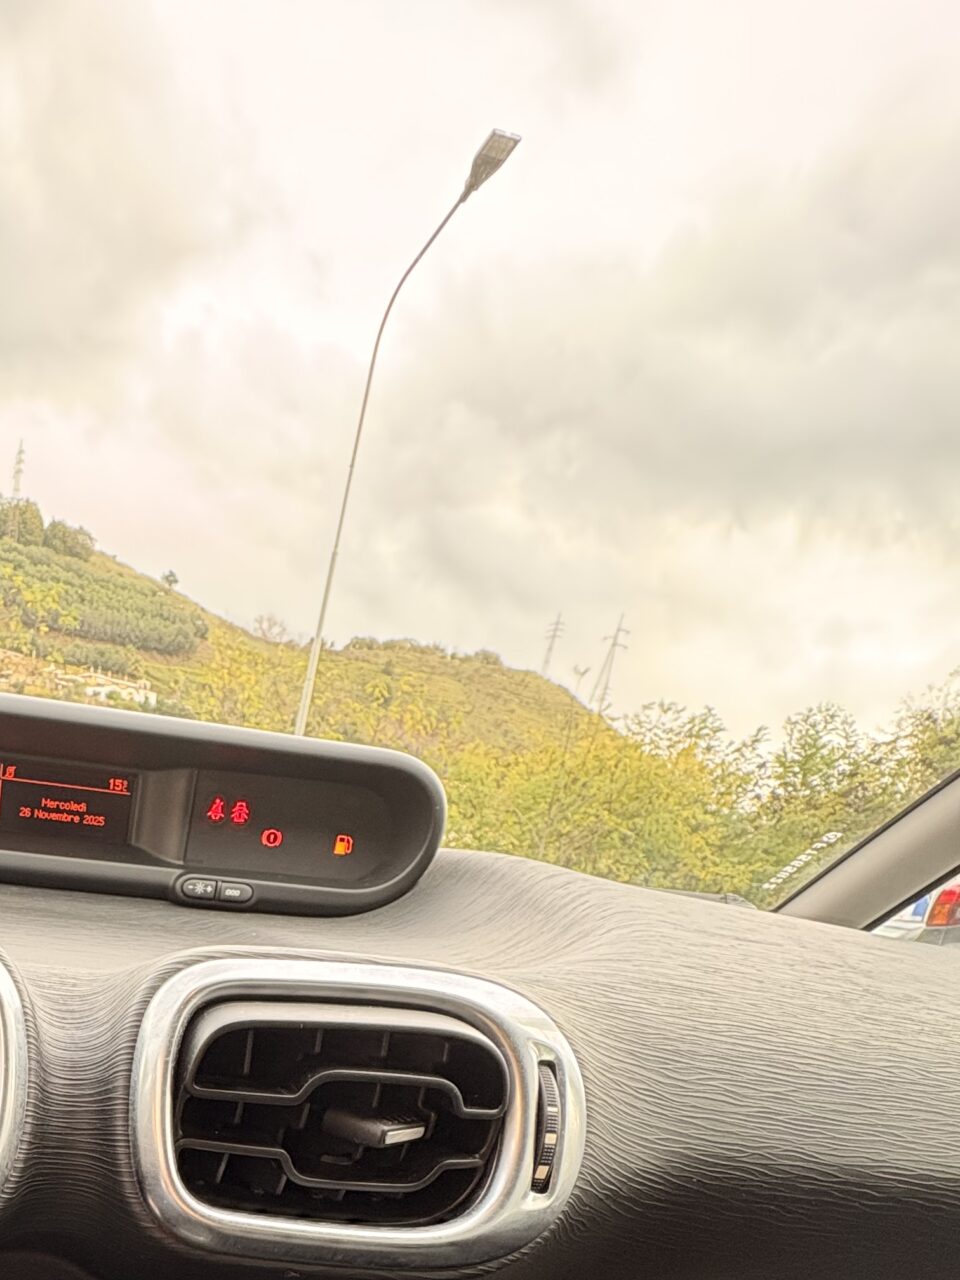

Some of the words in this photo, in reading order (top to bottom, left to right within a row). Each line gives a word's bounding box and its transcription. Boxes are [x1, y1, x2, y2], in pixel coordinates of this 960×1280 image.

[19, 807, 32, 818] 26
[34, 808, 80, 823] Novembre
[82, 814, 106, 827] 2025
